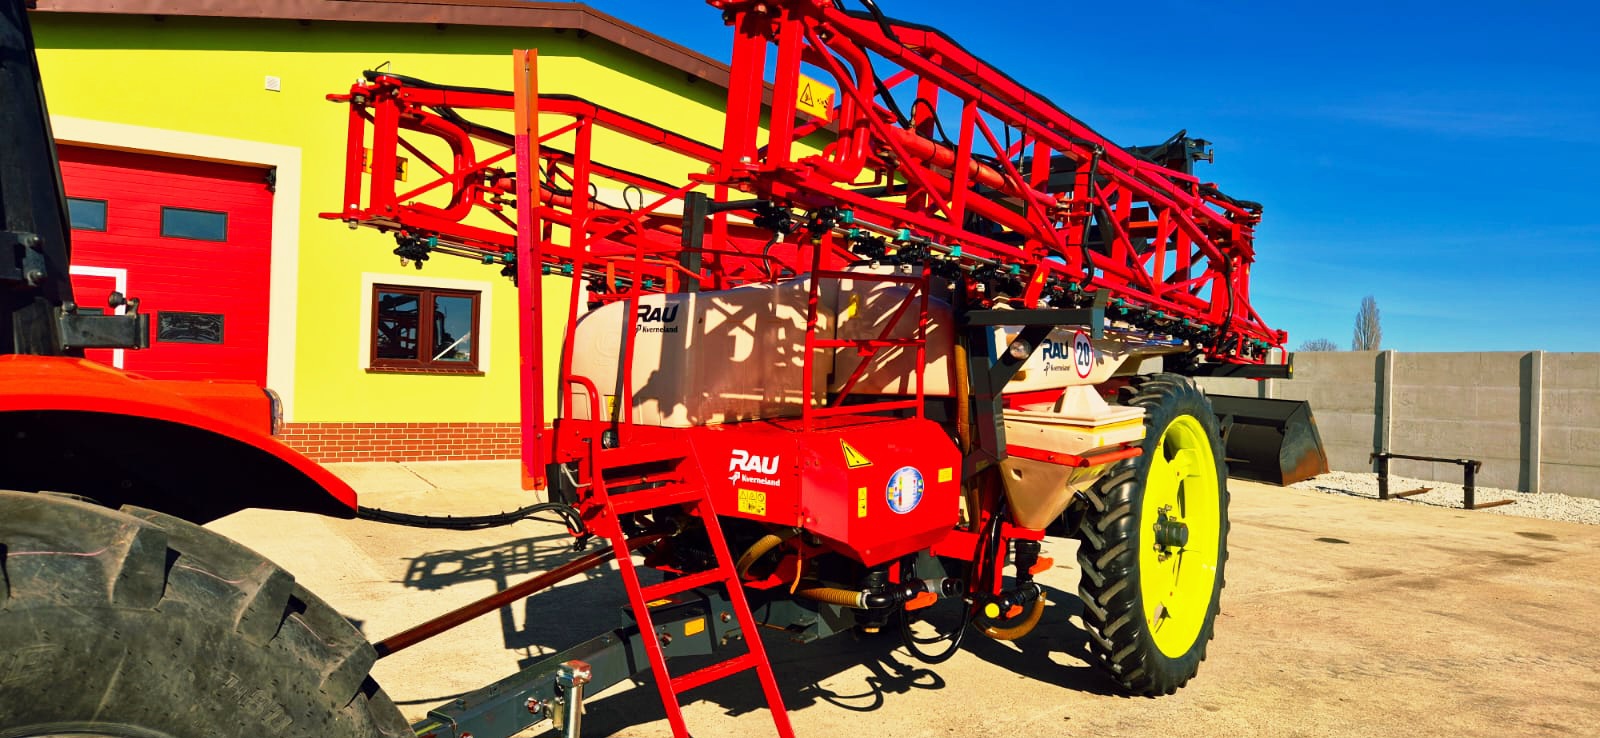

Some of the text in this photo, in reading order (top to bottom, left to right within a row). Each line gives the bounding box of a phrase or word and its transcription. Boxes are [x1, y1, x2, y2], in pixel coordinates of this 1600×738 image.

[638, 304, 679, 322] RAU
[642, 325, 678, 333] Kverneland
[1042, 339, 1068, 361] RAU
[1077, 341, 1089, 366] 20
[729, 449, 779, 474] RAU
[741, 474, 780, 486] Kverneland
